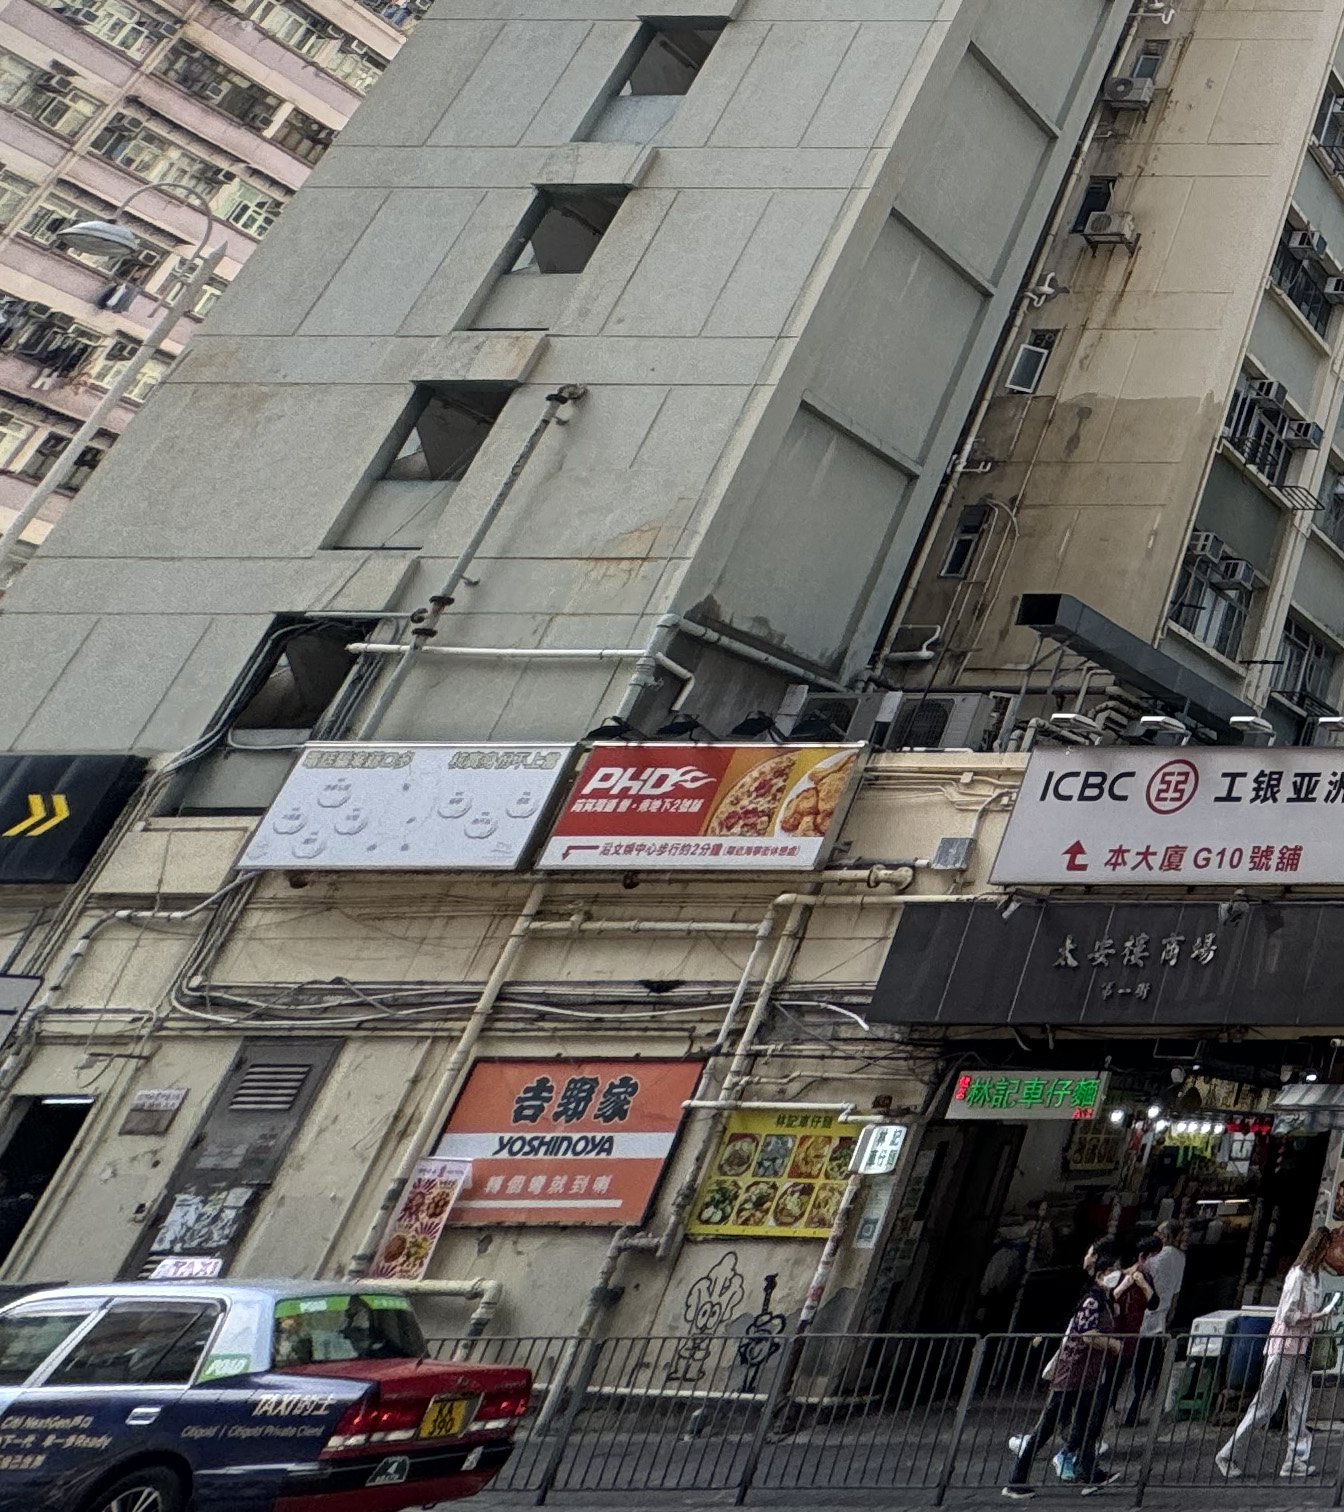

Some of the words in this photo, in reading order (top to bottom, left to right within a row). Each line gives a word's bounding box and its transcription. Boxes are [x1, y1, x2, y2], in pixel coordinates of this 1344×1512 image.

[580, 766, 677, 795] PHD
[1040, 771, 1136, 802] ICBC
[1104, 844, 1188, 872] 本大廈
[1193, 847, 1243, 871] G10
[966, 1076, 1100, 1109] 林記車仔麵
[492, 1136, 614, 1157] YOSHINOYA
[173, 1261, 219, 1276] TAXI
